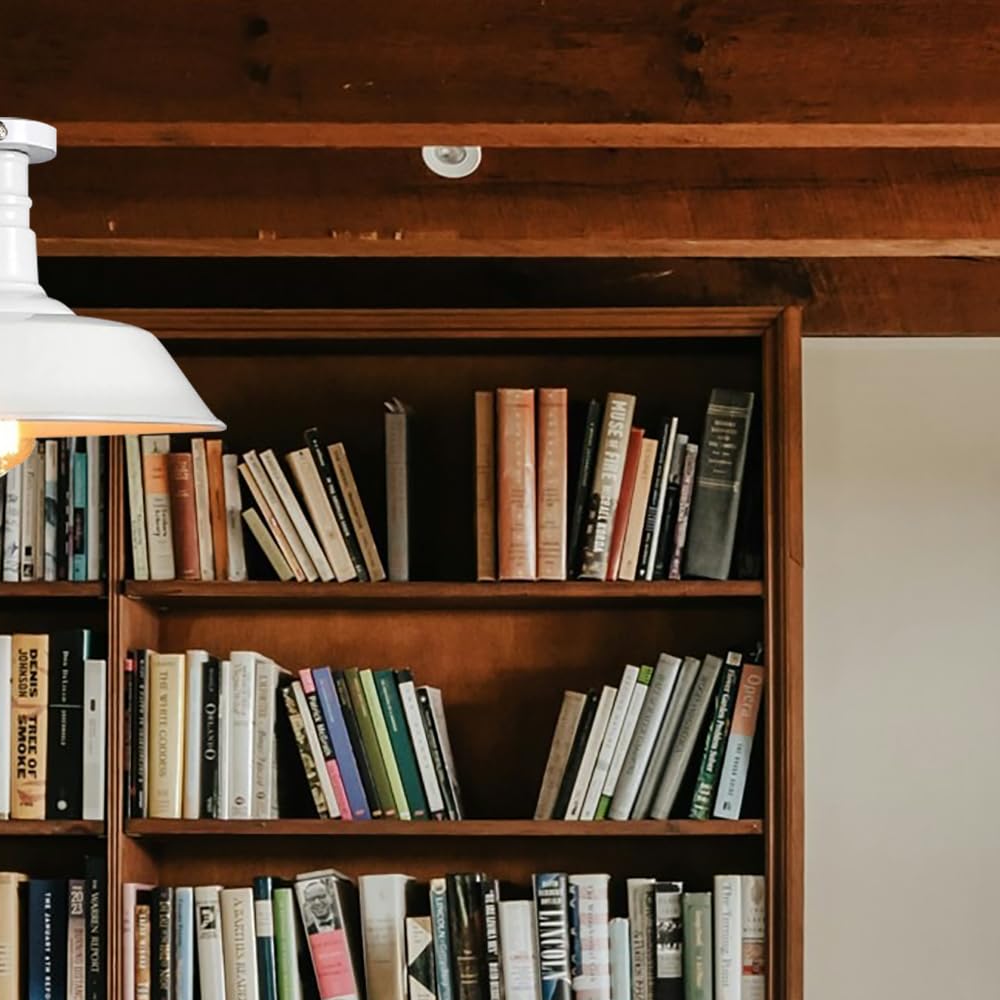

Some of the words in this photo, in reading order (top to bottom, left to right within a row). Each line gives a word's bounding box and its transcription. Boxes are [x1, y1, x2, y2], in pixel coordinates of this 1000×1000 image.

[612, 400, 627, 437] MUSE
[602, 451, 619, 480] FIRE
[18, 649, 28, 697] JOHNSON
[160, 672, 168, 691] THE
[160, 694, 168, 725] WHITE
[741, 674, 761, 717] Opera
[17, 715, 26, 779] SMOKE
[28, 715, 37, 754] TREE
[159, 730, 167, 777] GODDESS
[27, 759, 37, 778] OF
[539, 910, 567, 980] LINCOLN
